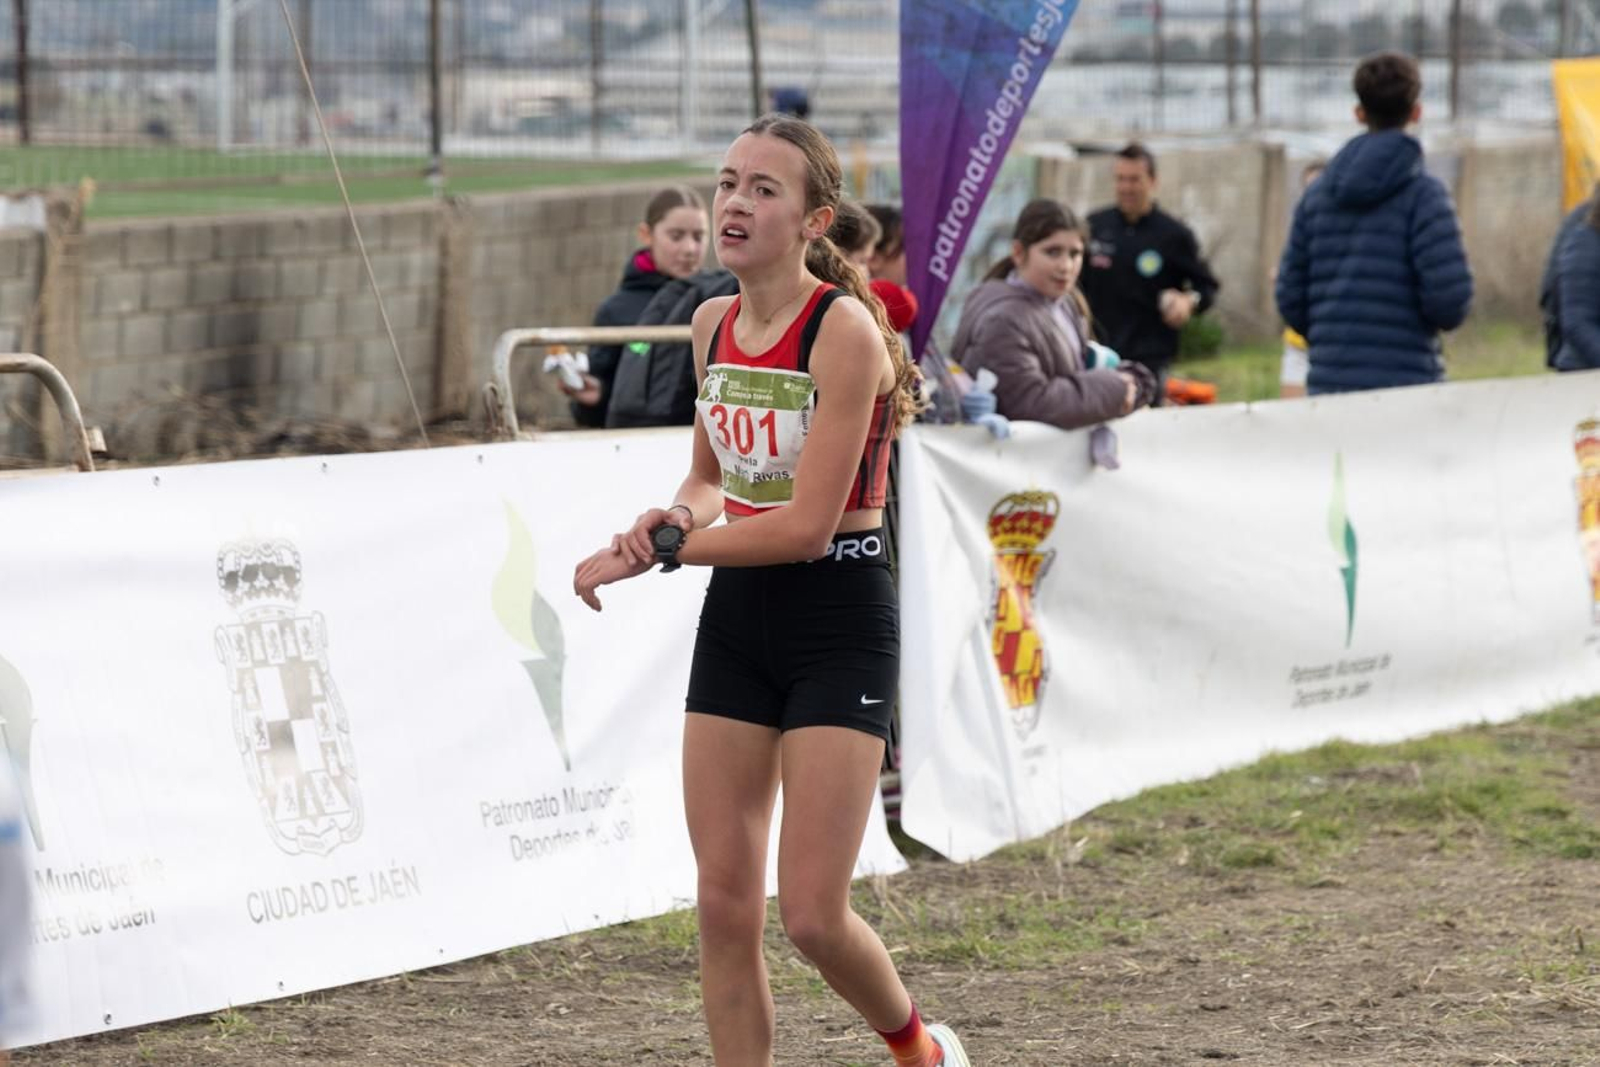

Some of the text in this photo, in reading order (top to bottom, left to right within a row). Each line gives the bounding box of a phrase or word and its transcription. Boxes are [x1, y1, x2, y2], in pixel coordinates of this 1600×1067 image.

[709, 403, 779, 457] 301
[753, 470, 790, 483] Rivas
[479, 791, 560, 828] Patronato
[246, 858, 423, 925] CIUDAD DE JAÉN
